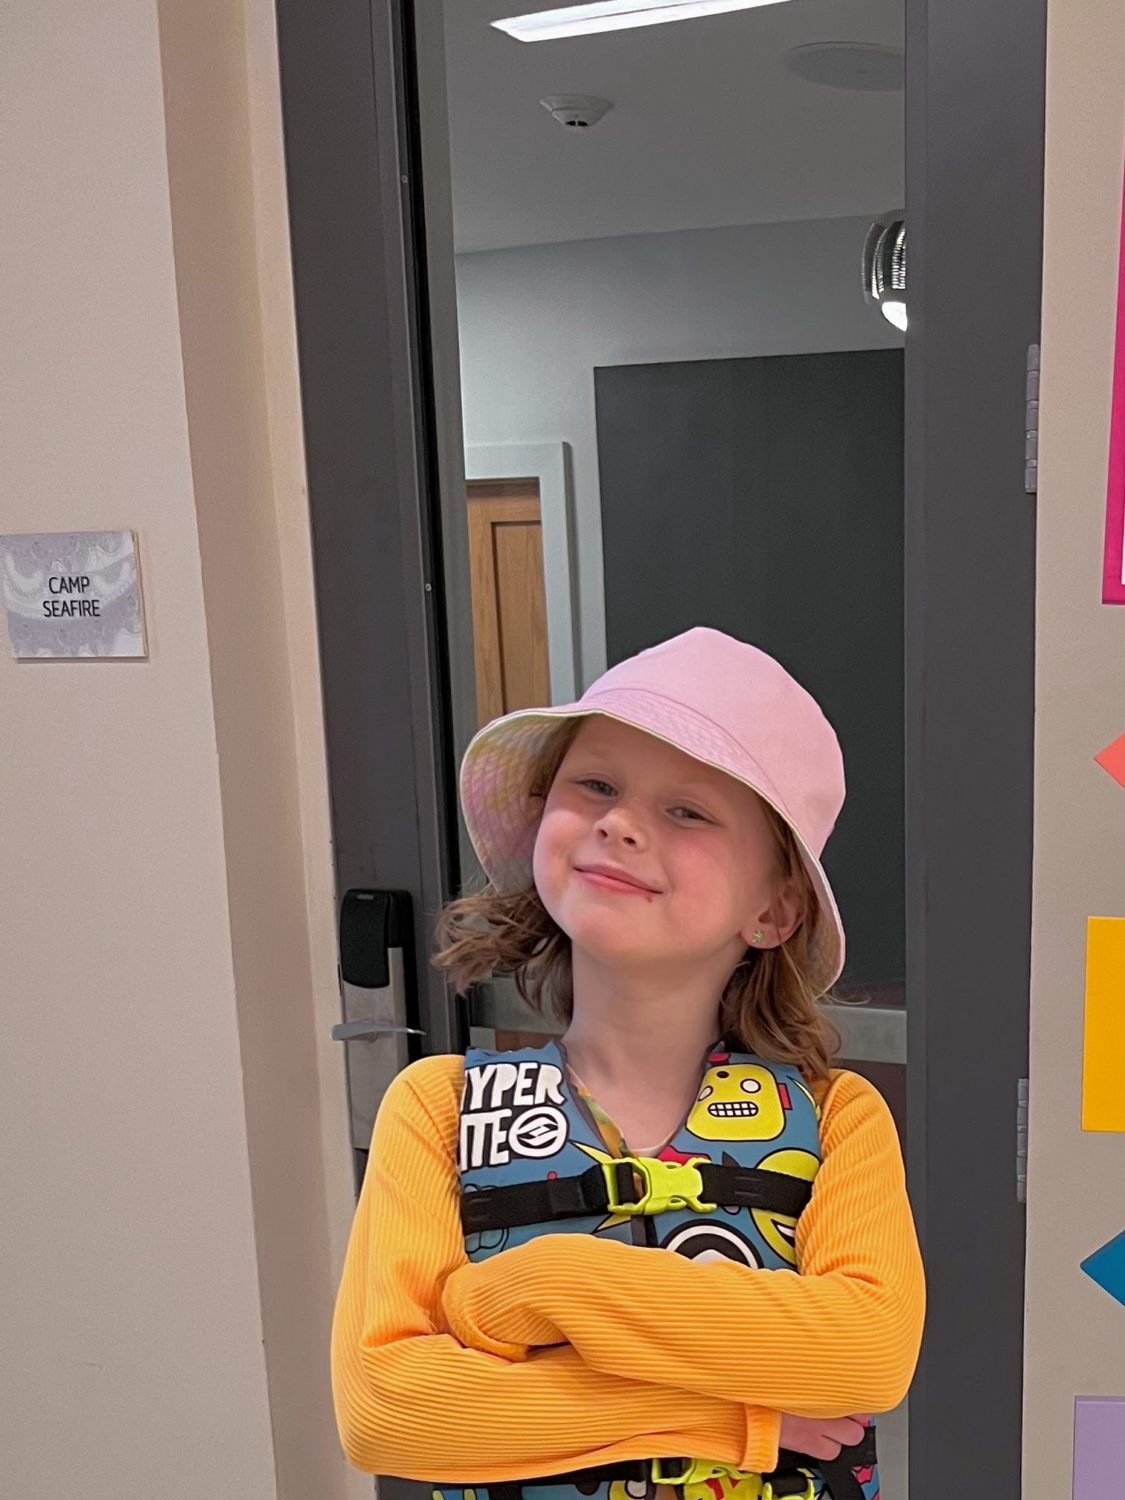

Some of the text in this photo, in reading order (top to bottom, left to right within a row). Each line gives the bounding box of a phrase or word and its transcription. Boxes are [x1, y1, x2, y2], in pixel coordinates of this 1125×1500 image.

[48, 576, 91, 594] CAMP
[42, 600, 101, 618] SEAFIRE
[460, 1108, 513, 1172] ITE
